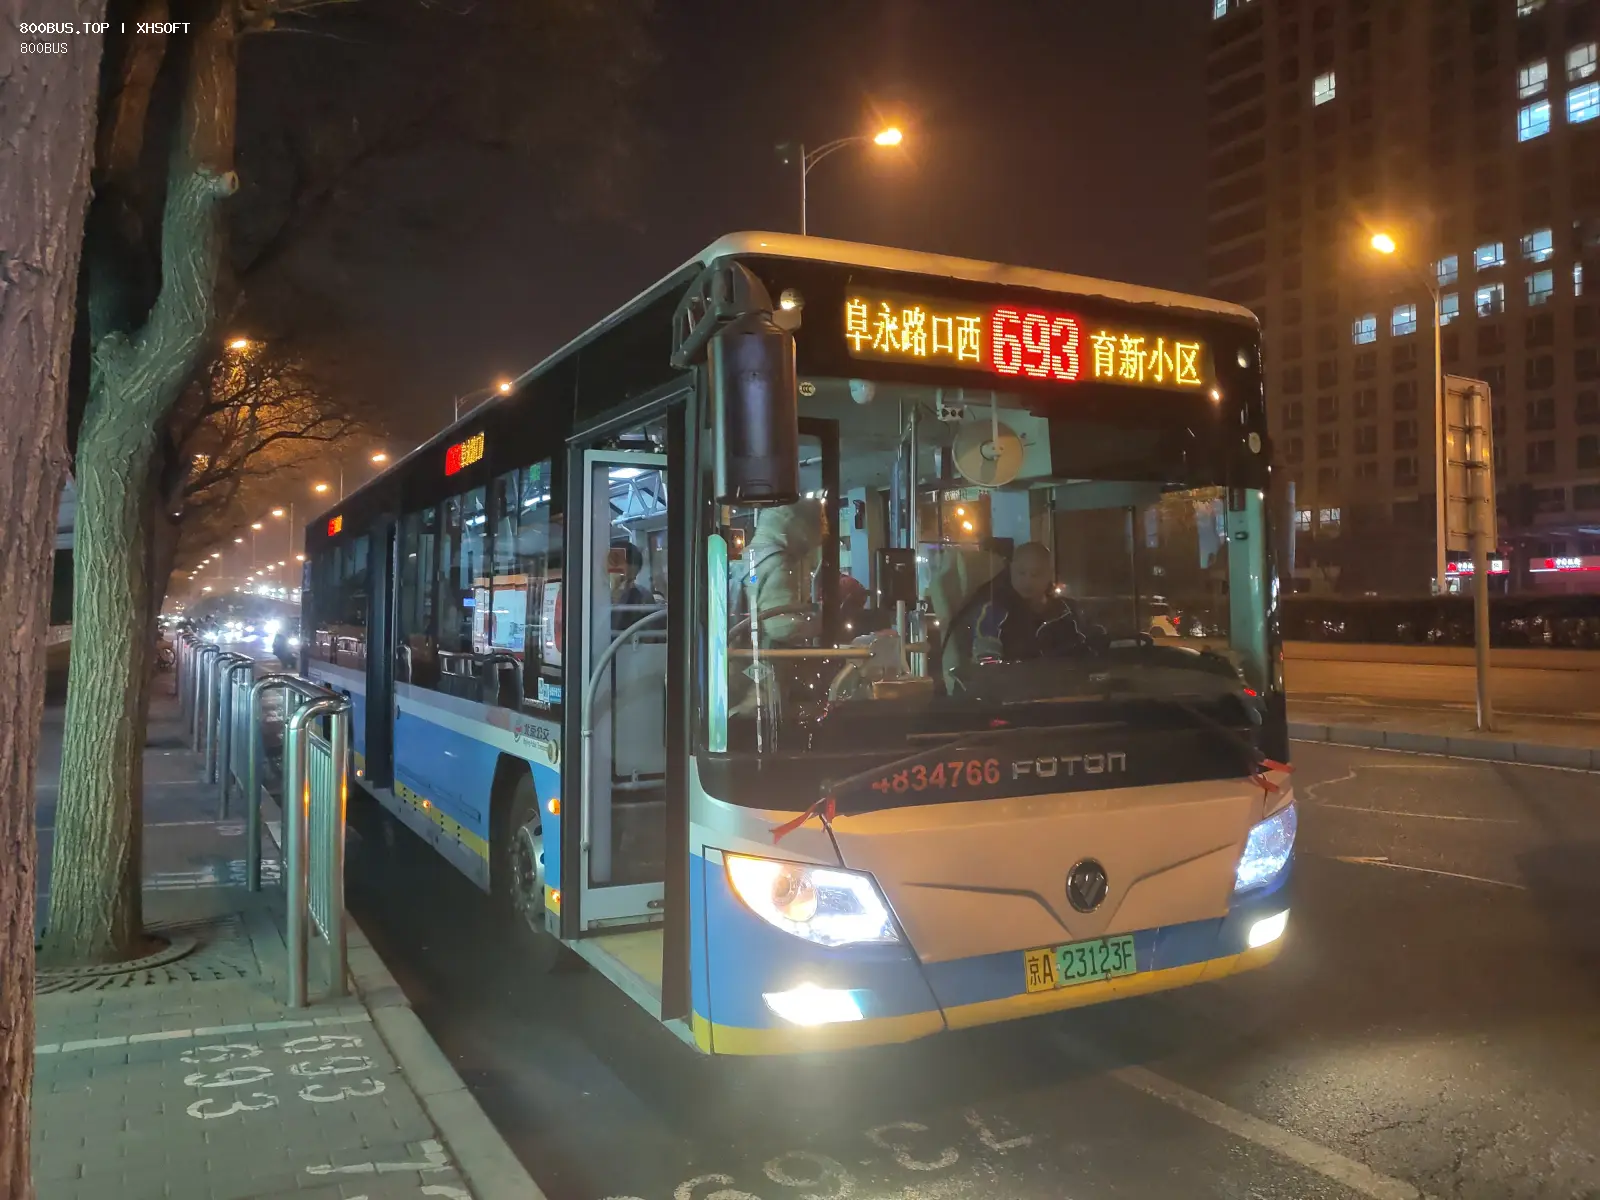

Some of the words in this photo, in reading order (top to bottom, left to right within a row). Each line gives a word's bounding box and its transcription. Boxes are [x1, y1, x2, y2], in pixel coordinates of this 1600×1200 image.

[845, 299, 982, 363] 阜永路口西
[991, 308, 1080, 381] 693
[1090, 331, 1202, 385] 育新小区
[1011, 752, 1126, 780] FOTON
